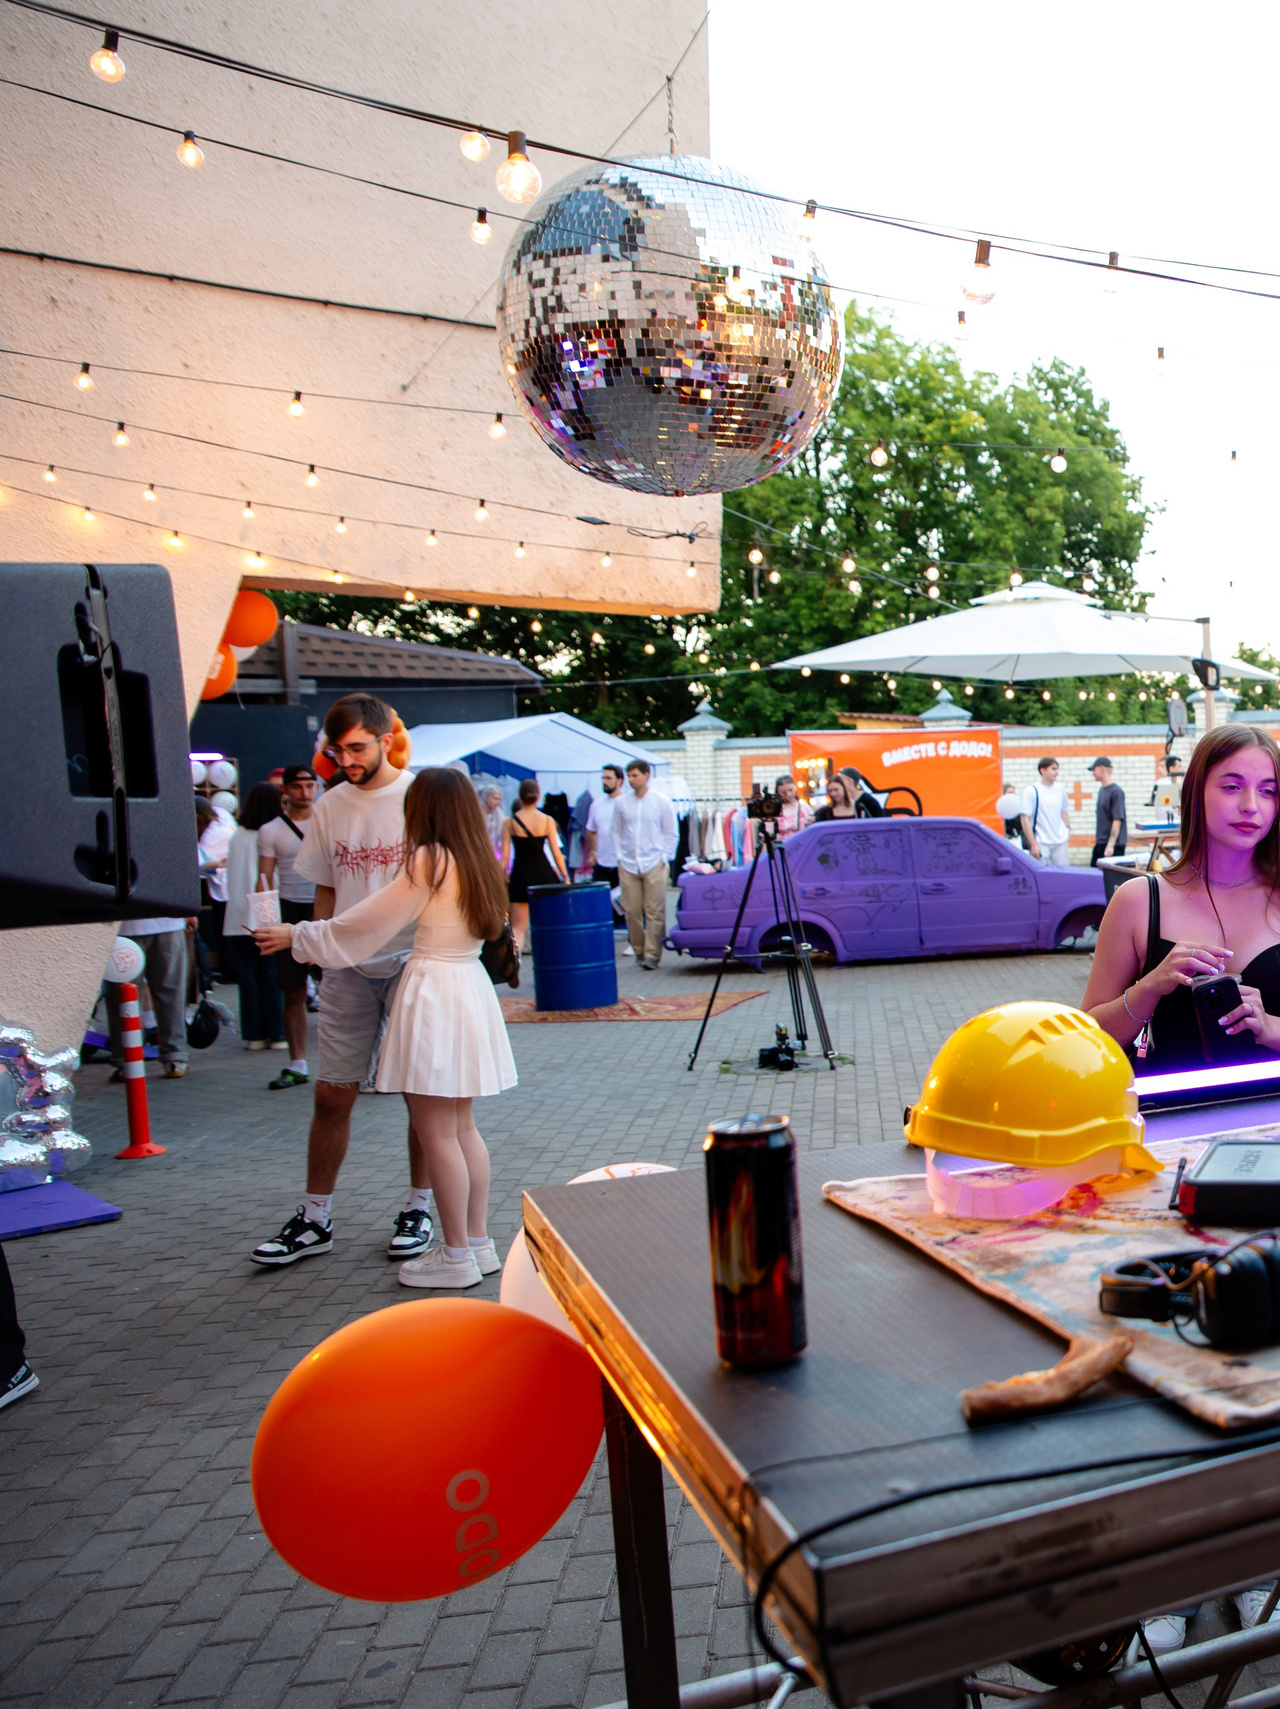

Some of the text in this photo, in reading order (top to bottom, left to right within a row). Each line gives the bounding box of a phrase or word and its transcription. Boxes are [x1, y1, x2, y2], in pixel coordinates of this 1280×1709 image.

[881, 740, 992, 767] ВМЕСТЕ С ДОДО!
[446, 1468, 502, 1591] ODO
